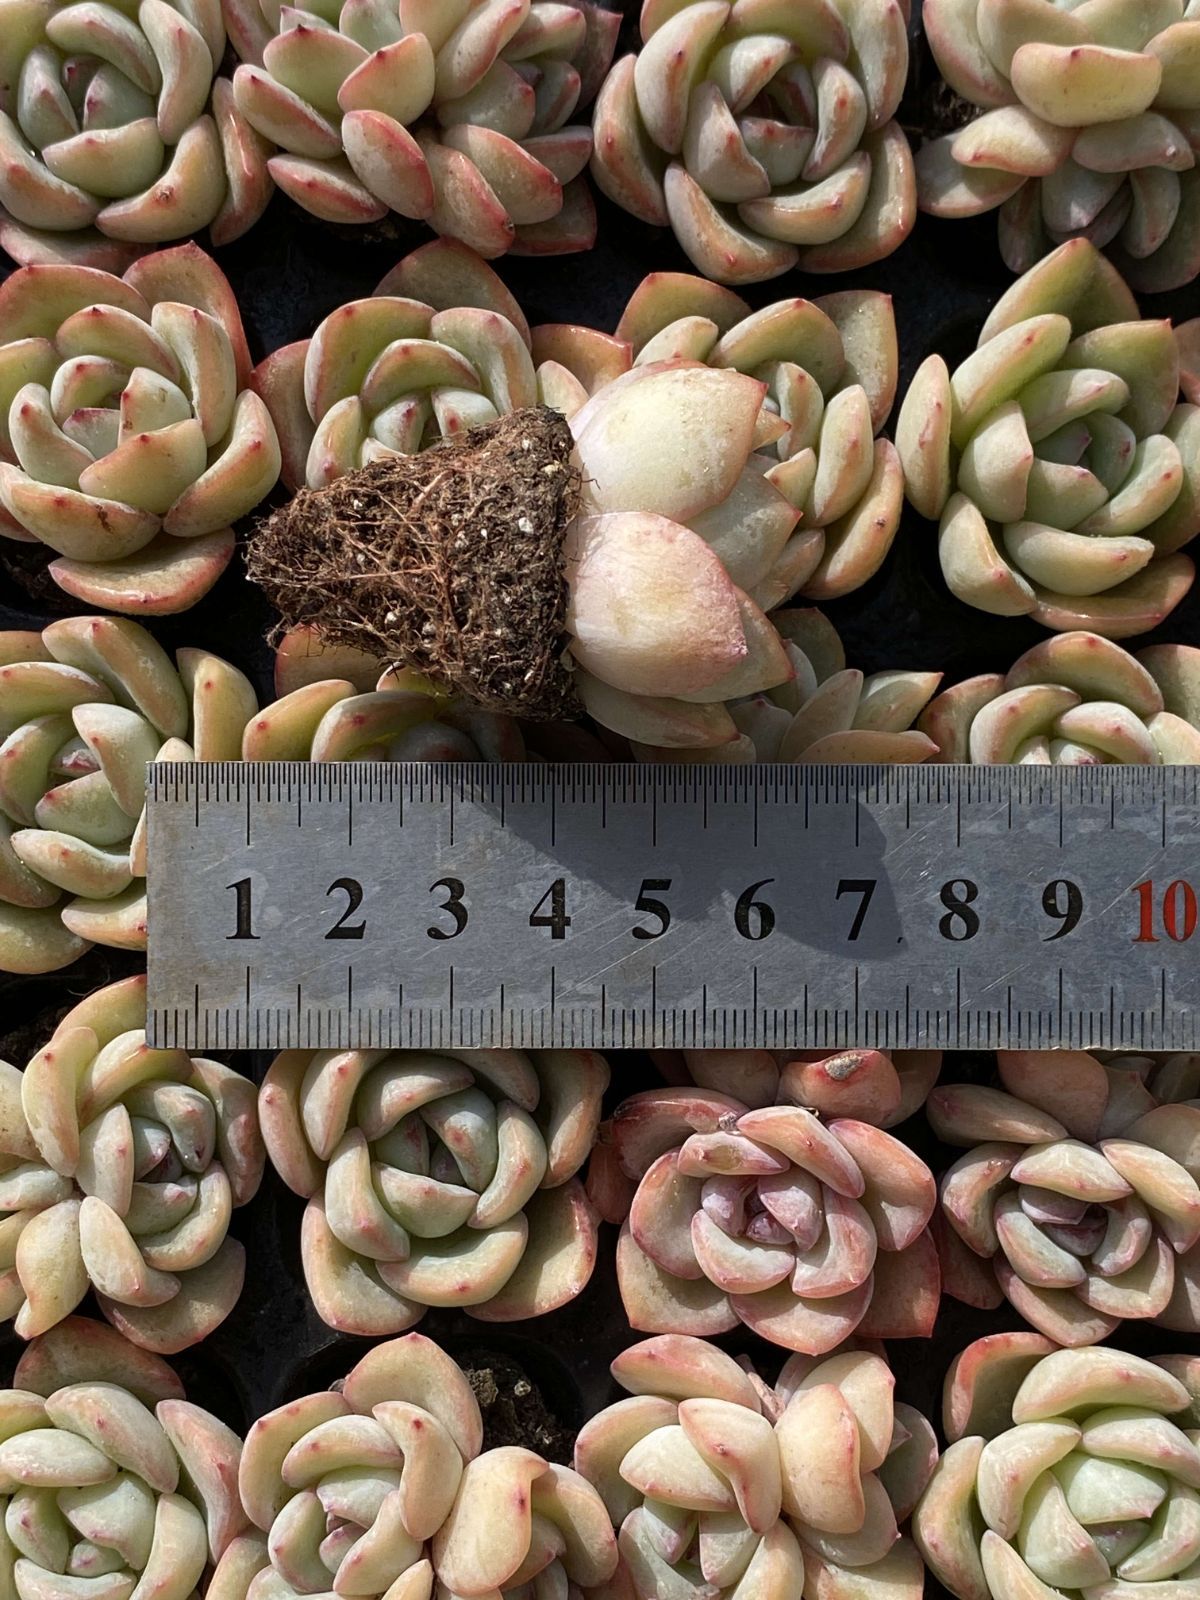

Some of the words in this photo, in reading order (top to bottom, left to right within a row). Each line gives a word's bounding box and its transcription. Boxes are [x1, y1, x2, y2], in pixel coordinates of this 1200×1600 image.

[225, 877, 261, 940] 1
[324, 877, 367, 940] 2
[426, 877, 469, 940] 3
[529, 877, 572, 940] 4
[631, 878, 673, 940] 5
[733, 878, 776, 941] 6
[834, 879, 878, 941] 7
[938, 879, 980, 942] 8
[1041, 879, 1084, 942] 9
[1131, 880, 1198, 943] 10
